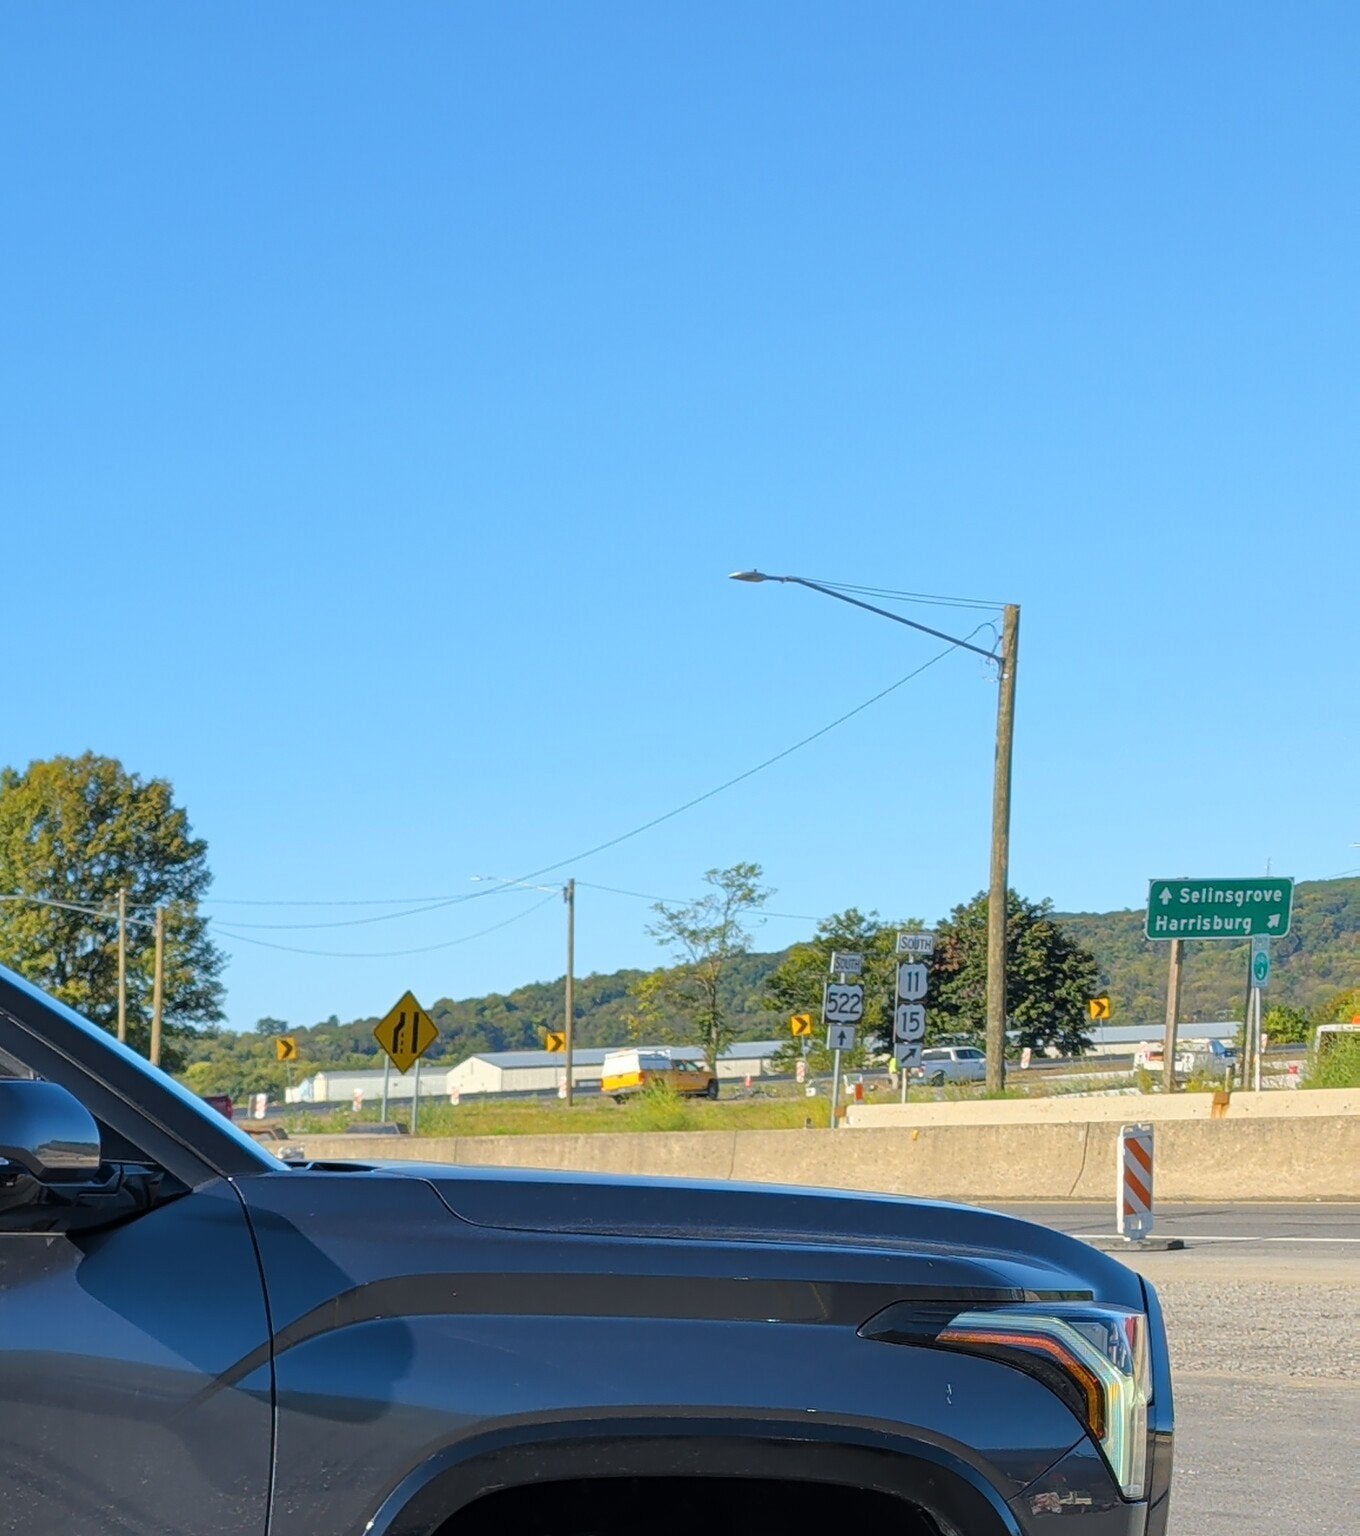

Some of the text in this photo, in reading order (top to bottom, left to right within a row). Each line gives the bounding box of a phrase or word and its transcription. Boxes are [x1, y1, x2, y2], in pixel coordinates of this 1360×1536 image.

[1179, 887, 1283, 907] Selinsgrove
[1155, 915, 1253, 934] Harrisburg
[900, 936, 932, 953] SOUTH
[834, 956, 861, 971] SOUTH
[907, 971, 920, 993] 11
[827, 992, 861, 1014] 522
[902, 1011, 920, 1032] 15
